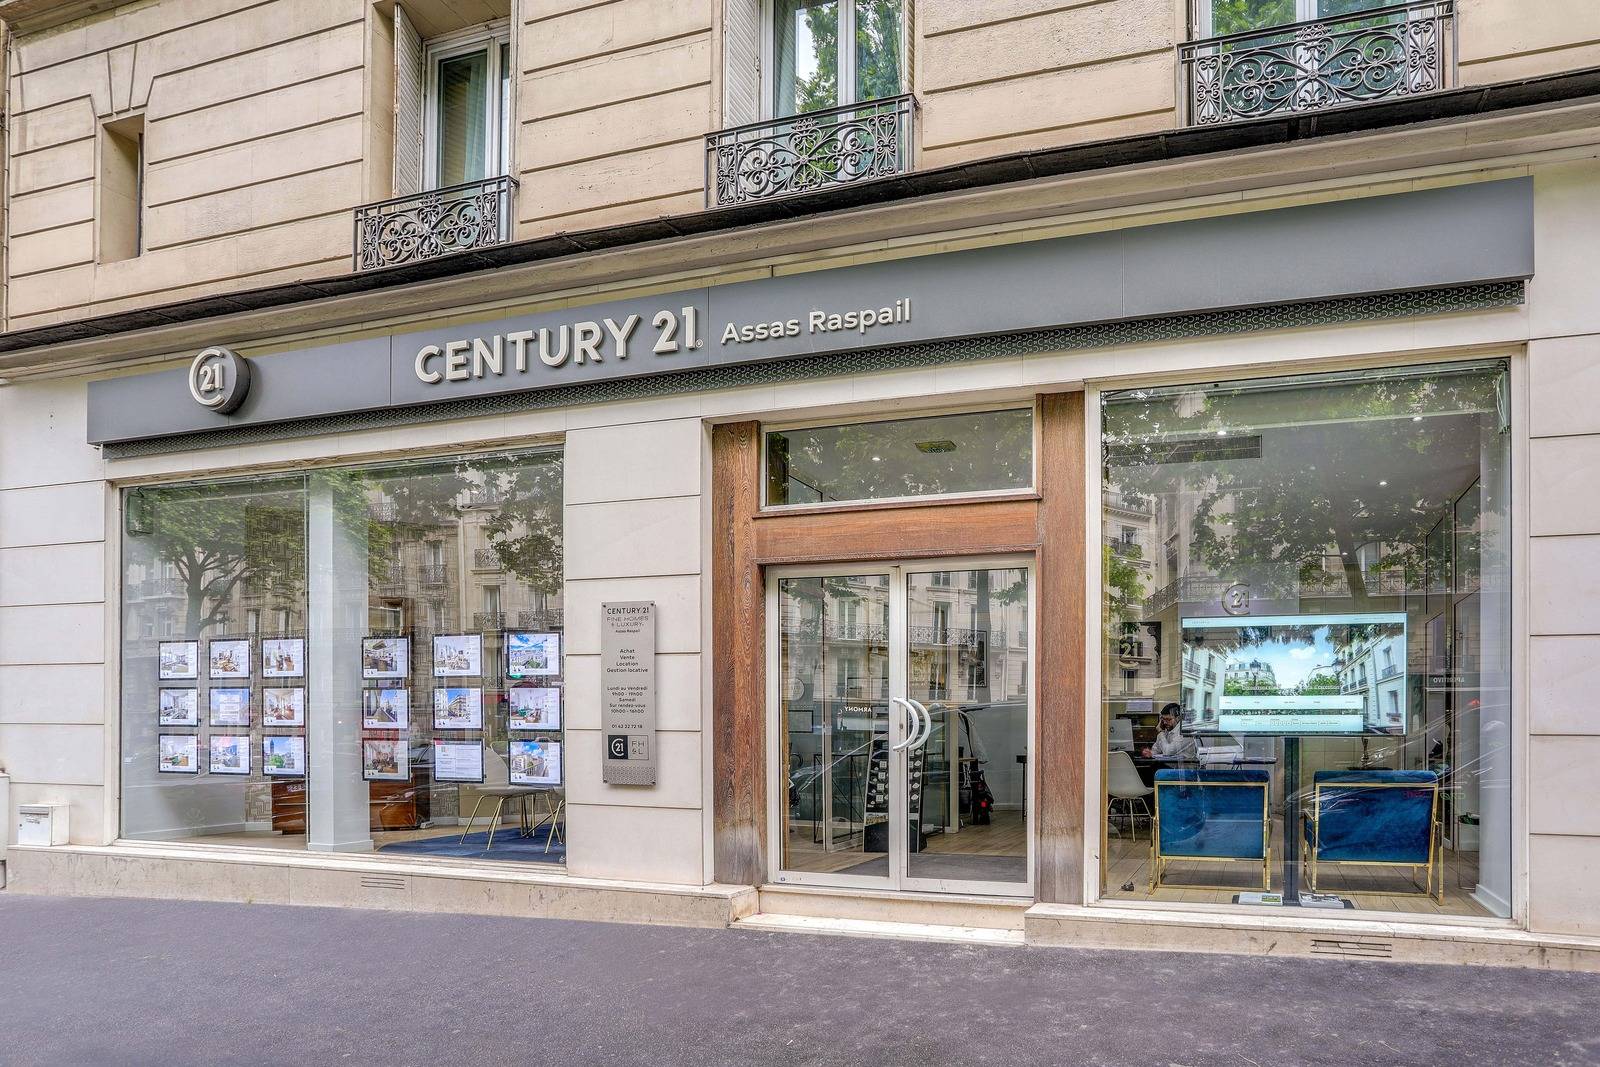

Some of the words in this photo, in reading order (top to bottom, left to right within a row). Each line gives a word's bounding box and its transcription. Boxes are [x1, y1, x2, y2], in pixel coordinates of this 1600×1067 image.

[720, 318, 801, 345] Assas
[808, 298, 912, 334] Raspail
[415, 312, 641, 384] CENTURY
[606, 607, 641, 615] CENTURY
